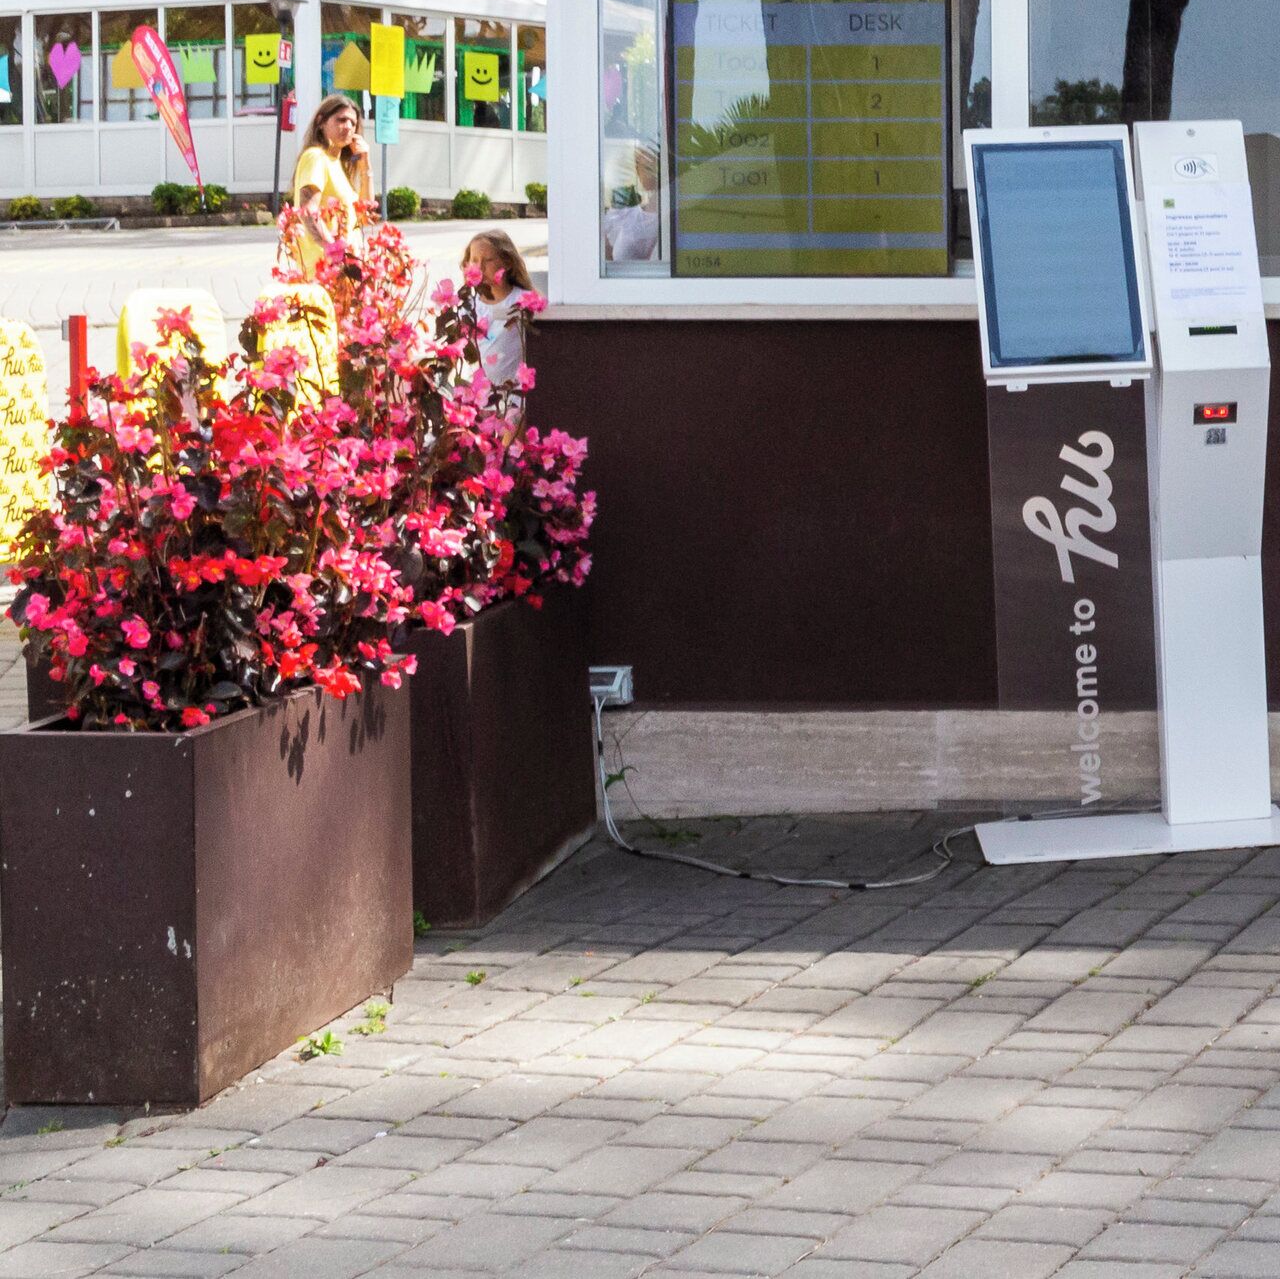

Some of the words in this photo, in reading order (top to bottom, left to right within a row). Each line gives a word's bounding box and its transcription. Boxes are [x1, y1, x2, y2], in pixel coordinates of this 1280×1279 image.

[707, 13, 778, 32] TICKET
[849, 13, 903, 32] DESK
[873, 55, 881, 71] 1
[870, 93, 883, 110] 2
[874, 132, 881, 148] 1
[873, 170, 881, 186] 1
[1022, 430, 1119, 583] hu
[1070, 598, 1097, 635] to
[1070, 642, 1102, 807] welcome
